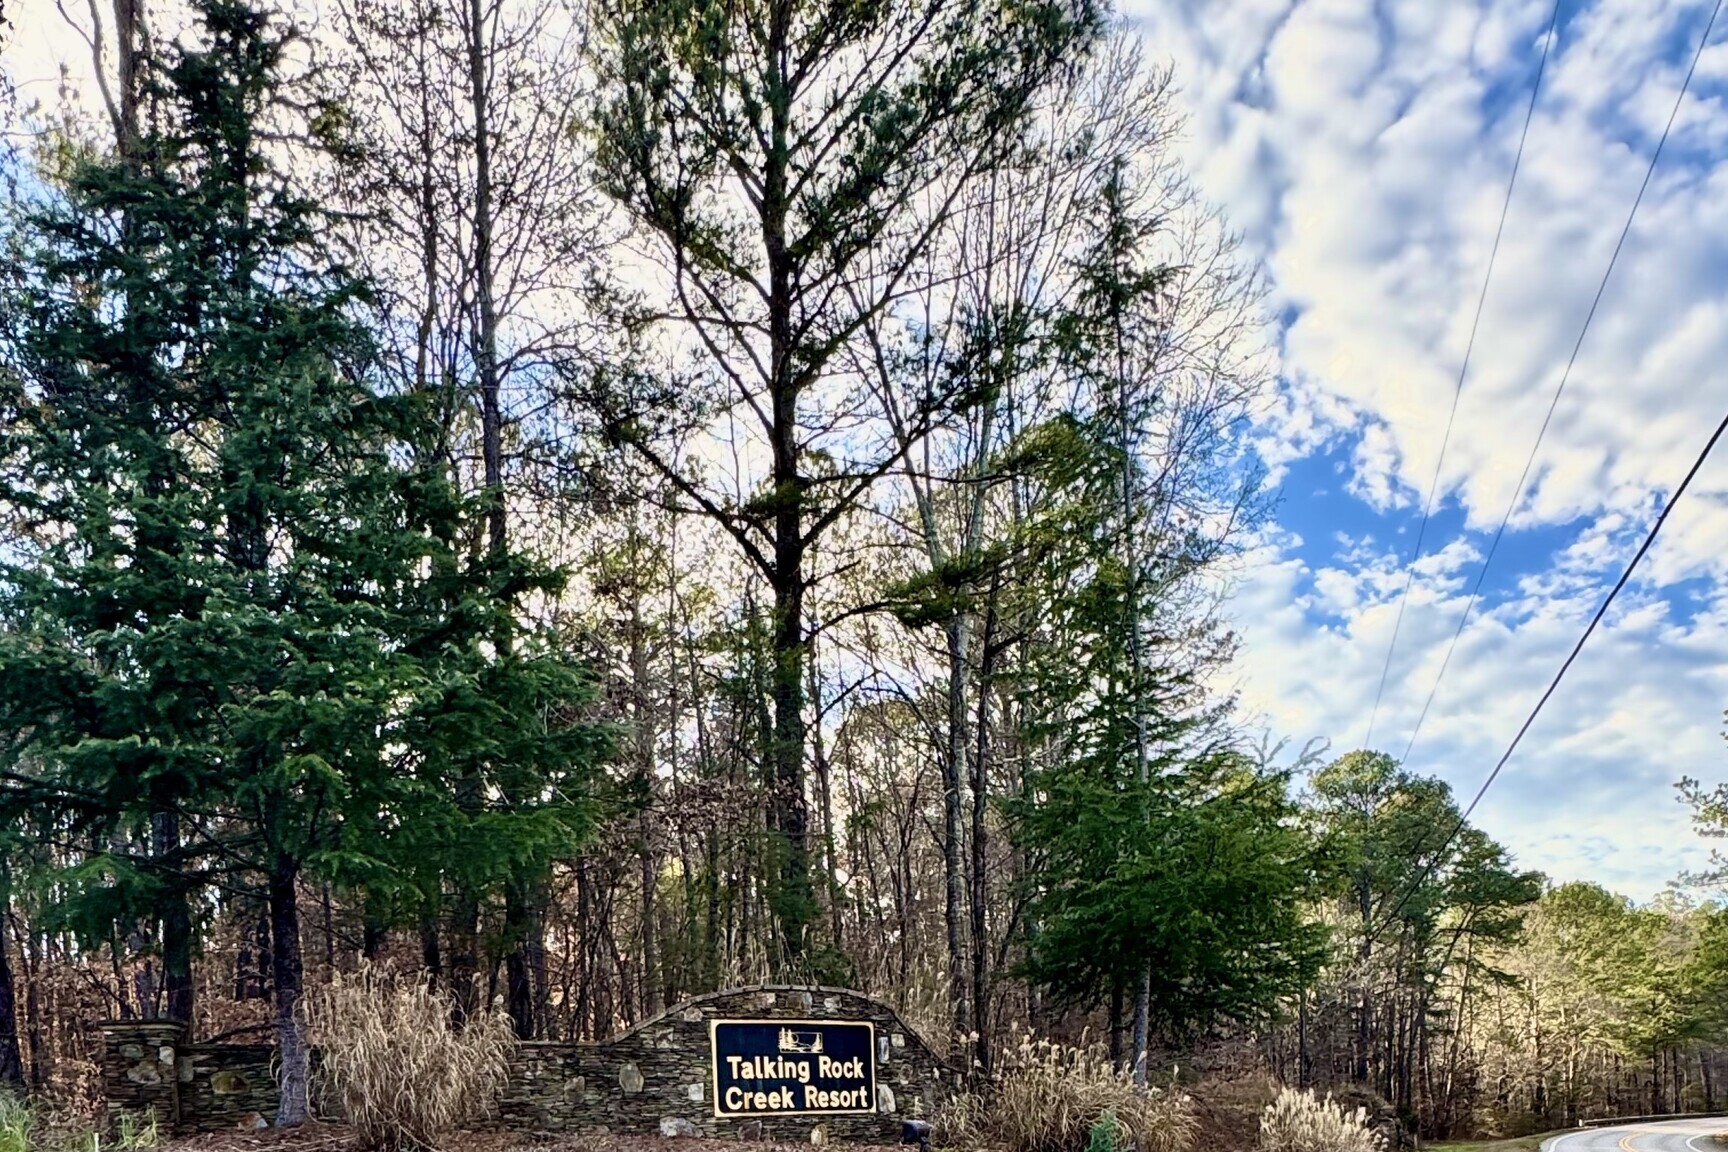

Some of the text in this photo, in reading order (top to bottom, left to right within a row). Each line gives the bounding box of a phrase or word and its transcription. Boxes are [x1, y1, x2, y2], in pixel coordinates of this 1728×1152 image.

[726, 1055, 865, 1083] Talking Rock
[725, 1085, 868, 1110] Creek Resort
